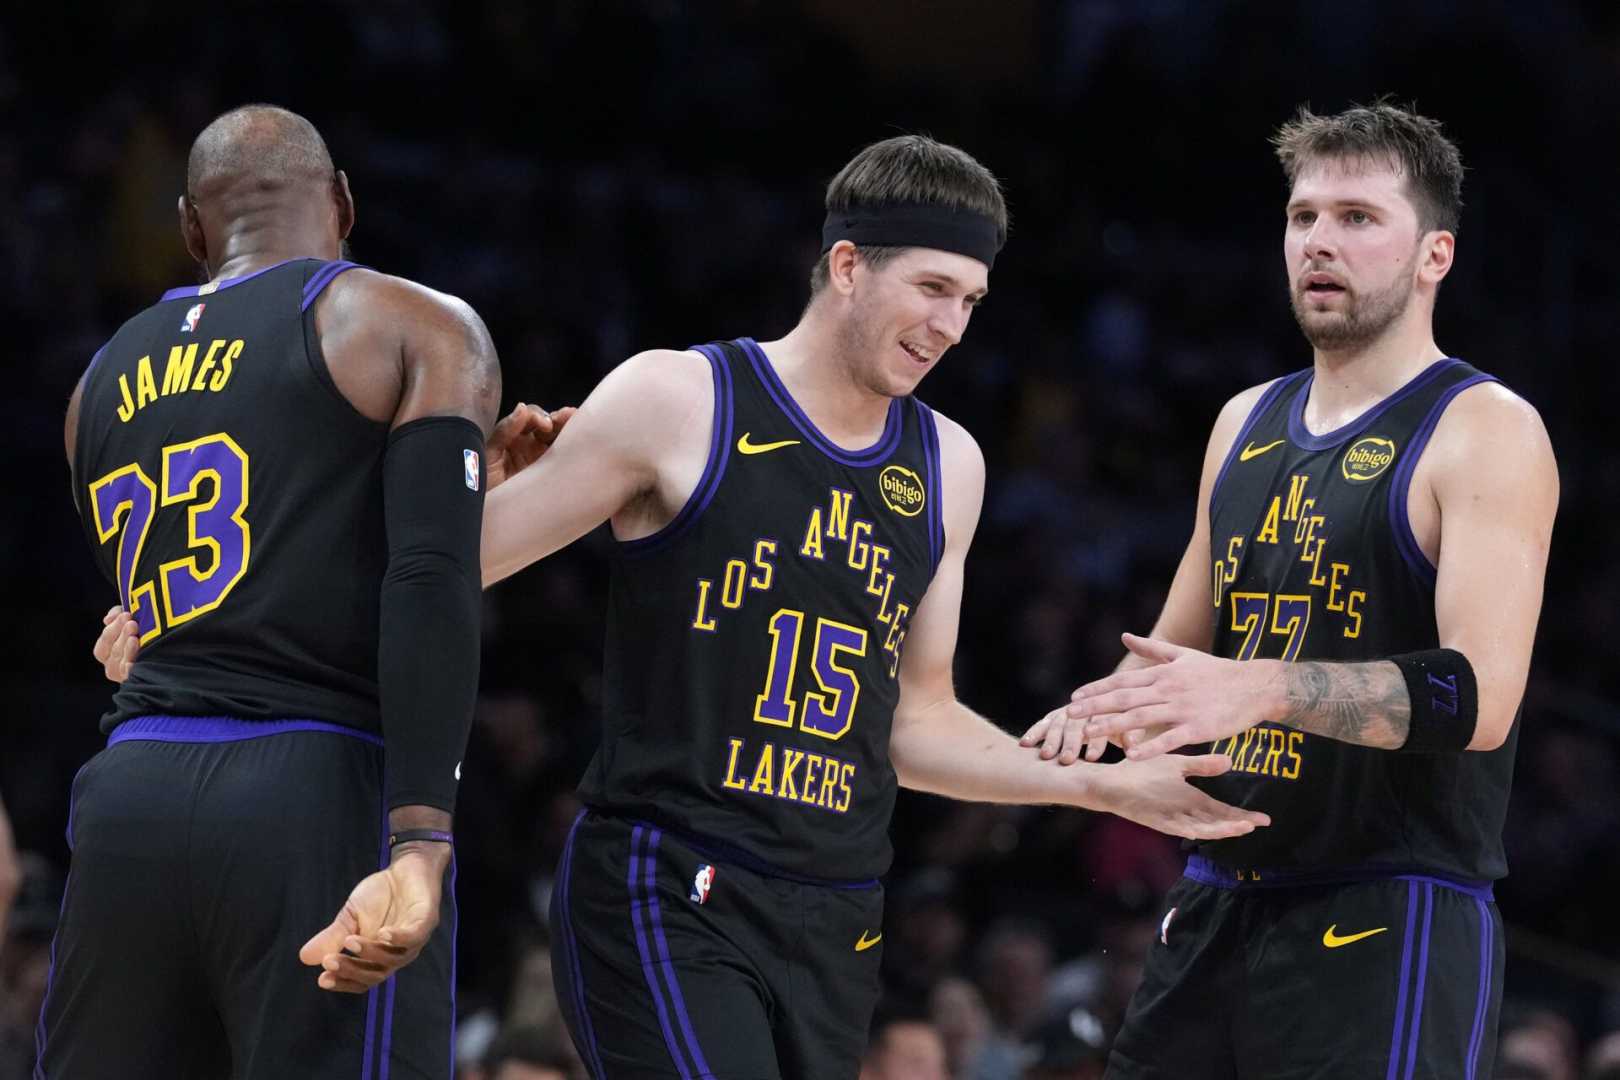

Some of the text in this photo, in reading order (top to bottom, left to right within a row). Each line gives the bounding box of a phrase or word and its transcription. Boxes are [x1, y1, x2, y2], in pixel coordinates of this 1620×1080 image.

[117, 338, 244, 423] JAMES
[883, 475, 922, 504] bibigo
[1348, 448, 1390, 468] bibigo
[88, 432, 251, 646] 23
[1213, 475, 1367, 639] OS ANGELES
[692, 488, 910, 679] LOS ANGELES
[1230, 591, 1312, 663] 77
[753, 606, 869, 741] 15
[722, 737, 856, 814] LAKERS
